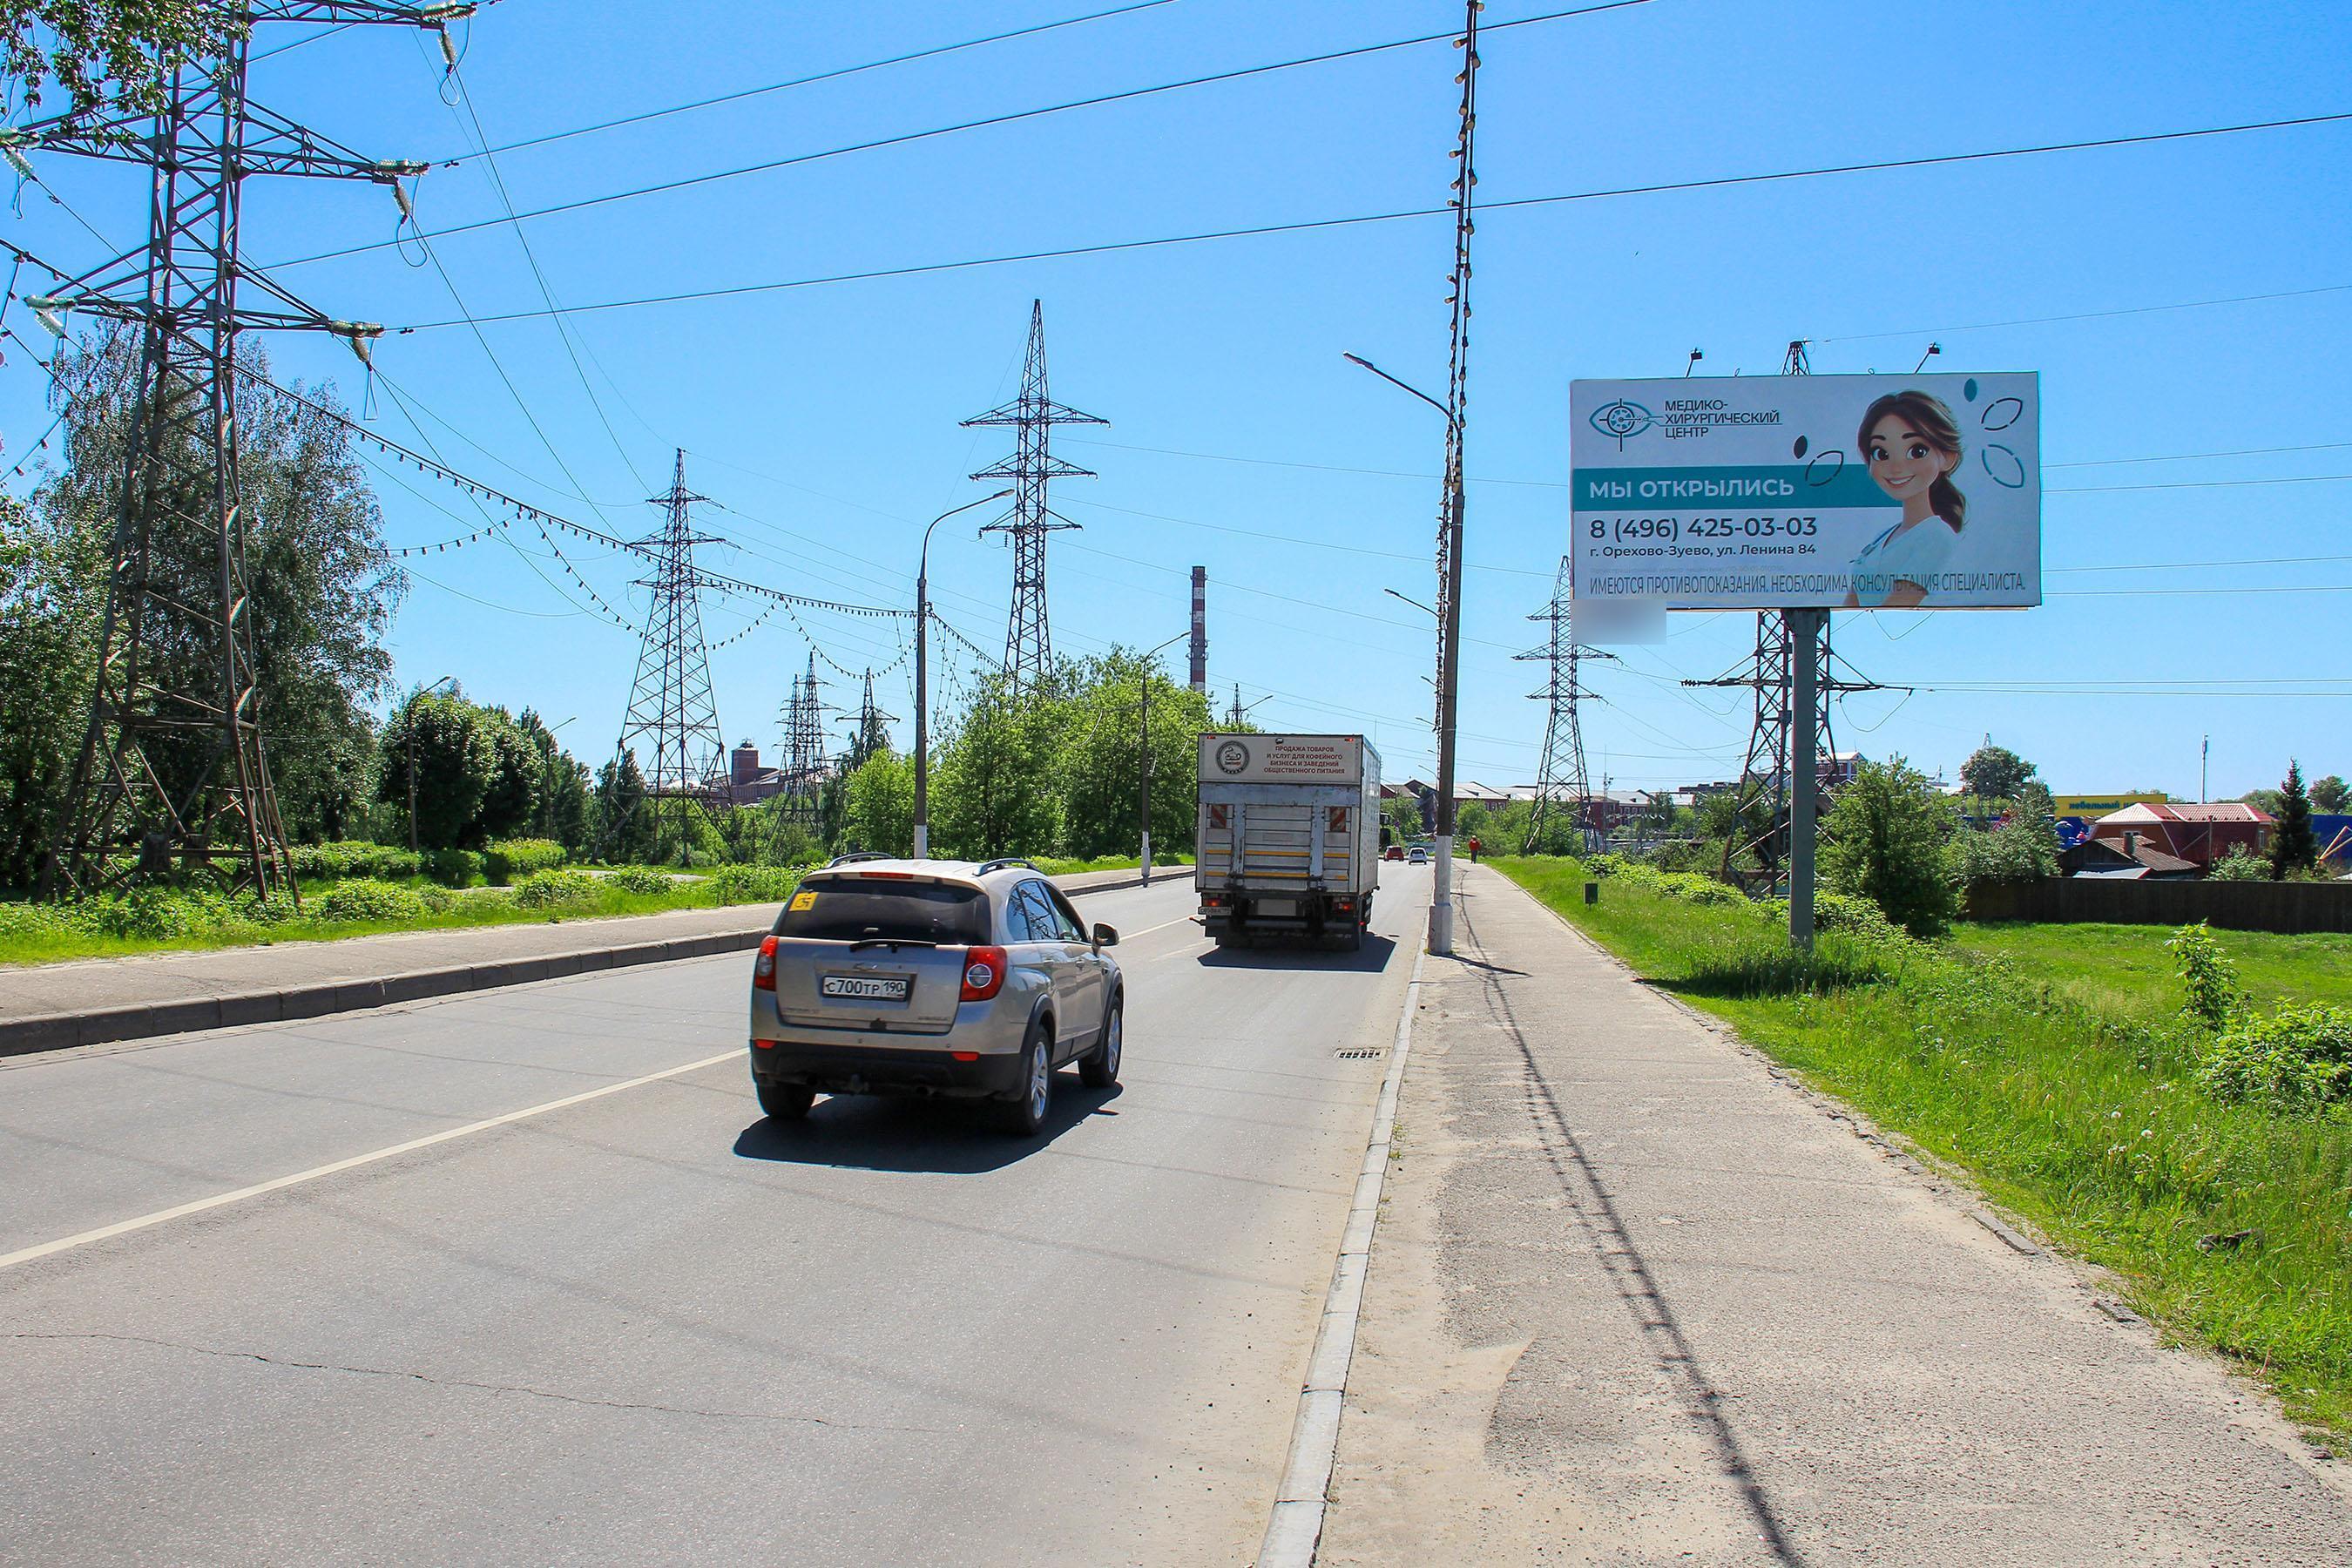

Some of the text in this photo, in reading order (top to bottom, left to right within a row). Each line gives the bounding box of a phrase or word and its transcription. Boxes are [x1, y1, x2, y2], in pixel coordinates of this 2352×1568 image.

[1665, 400, 1728, 413] МЕДИКО-
[1665, 410, 1780, 424] ХИРУРГИЧЕСКИЙ
[1665, 427, 1708, 440] ЦЕНТР
[1590, 478, 1794, 498] МЫ ОТКРЫЛИСЬ
[1590, 517, 1818, 543] 8 (496) 425-03-03
[1590, 544, 1816, 558] г. Орехово-Зуево, ул. Ленина 84
[1590, 573, 2026, 595] ИМЕЮТСЯ ПРОТИВОПОКАЗАНИЯ. НЕОБХОДИМА КОНСУЛЬТАЦИЯ СПЕЦИАЛИСТА.
[883, 981, 903, 992] 190
